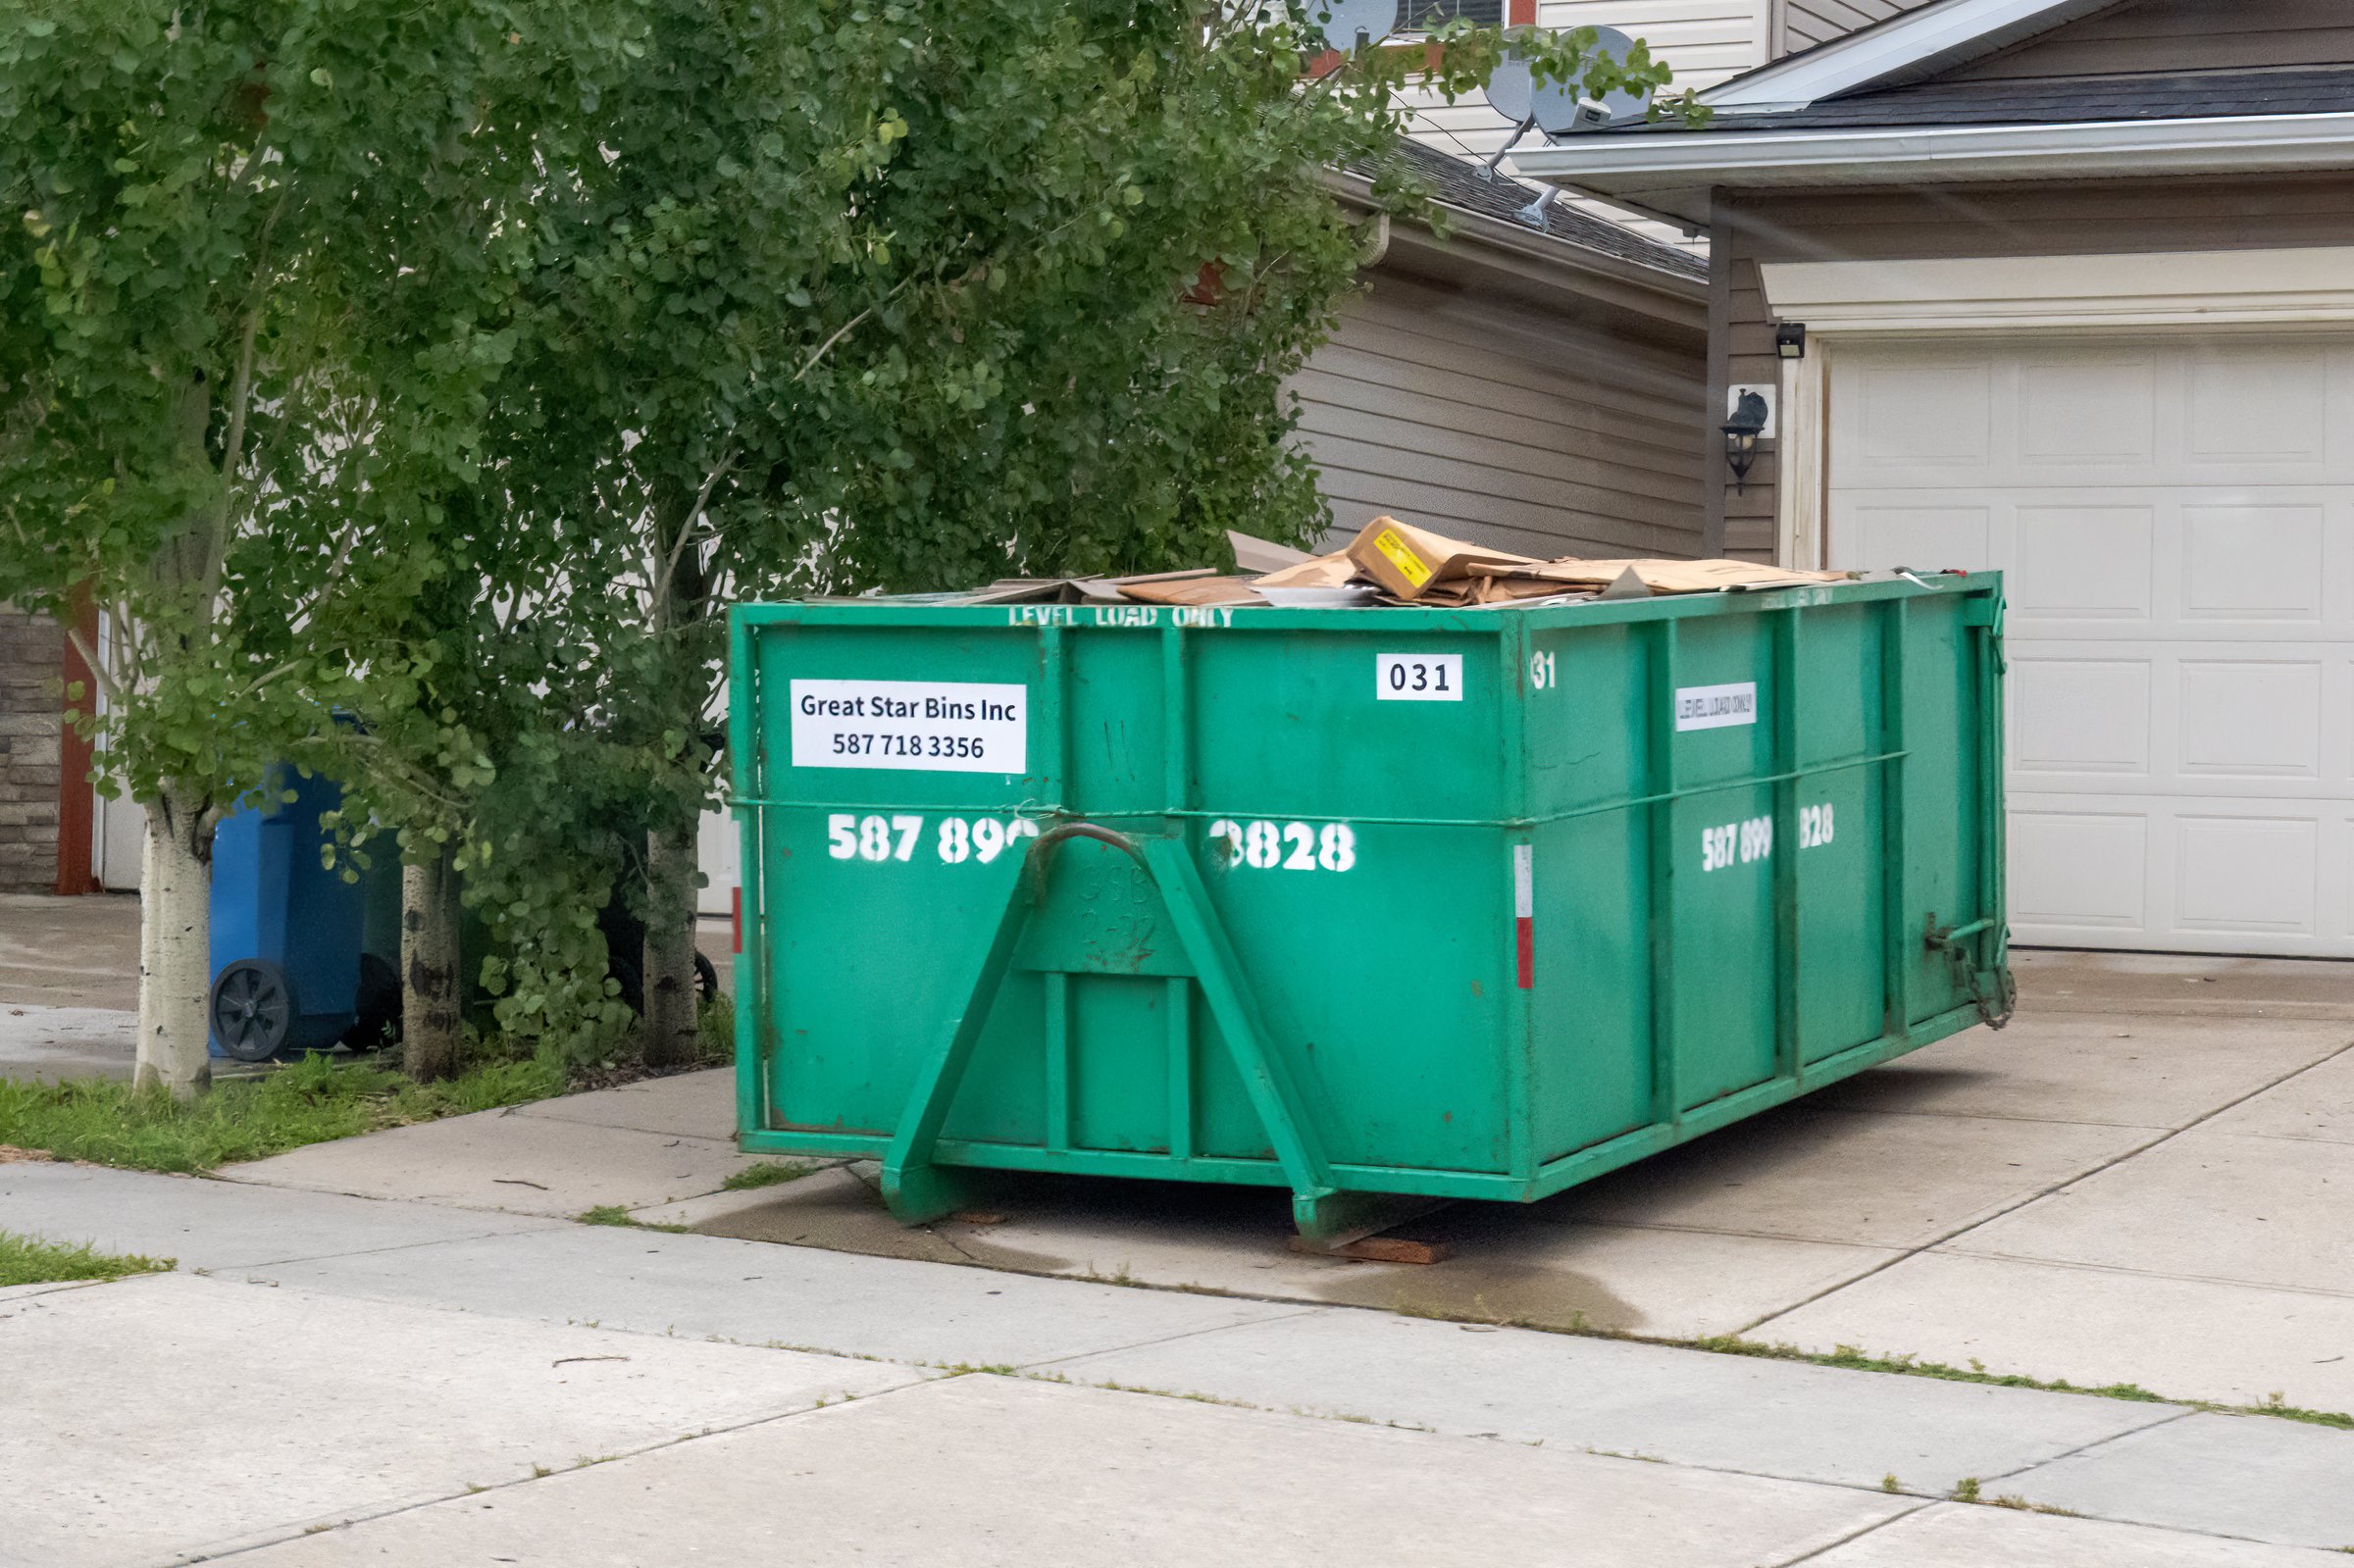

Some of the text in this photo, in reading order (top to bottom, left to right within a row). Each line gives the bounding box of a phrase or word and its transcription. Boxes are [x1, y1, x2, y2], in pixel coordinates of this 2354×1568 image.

[1008, 606, 1234, 628] LEVEL LOAD ONLY
[1390, 663, 1450, 691] 031
[1530, 650, 1556, 690] 31
[800, 694, 1016, 722] Great Star Bins Inc
[833, 733, 985, 759] 587 718 3356
[828, 814, 924, 863] 587
[1702, 823, 1738, 872] 587
